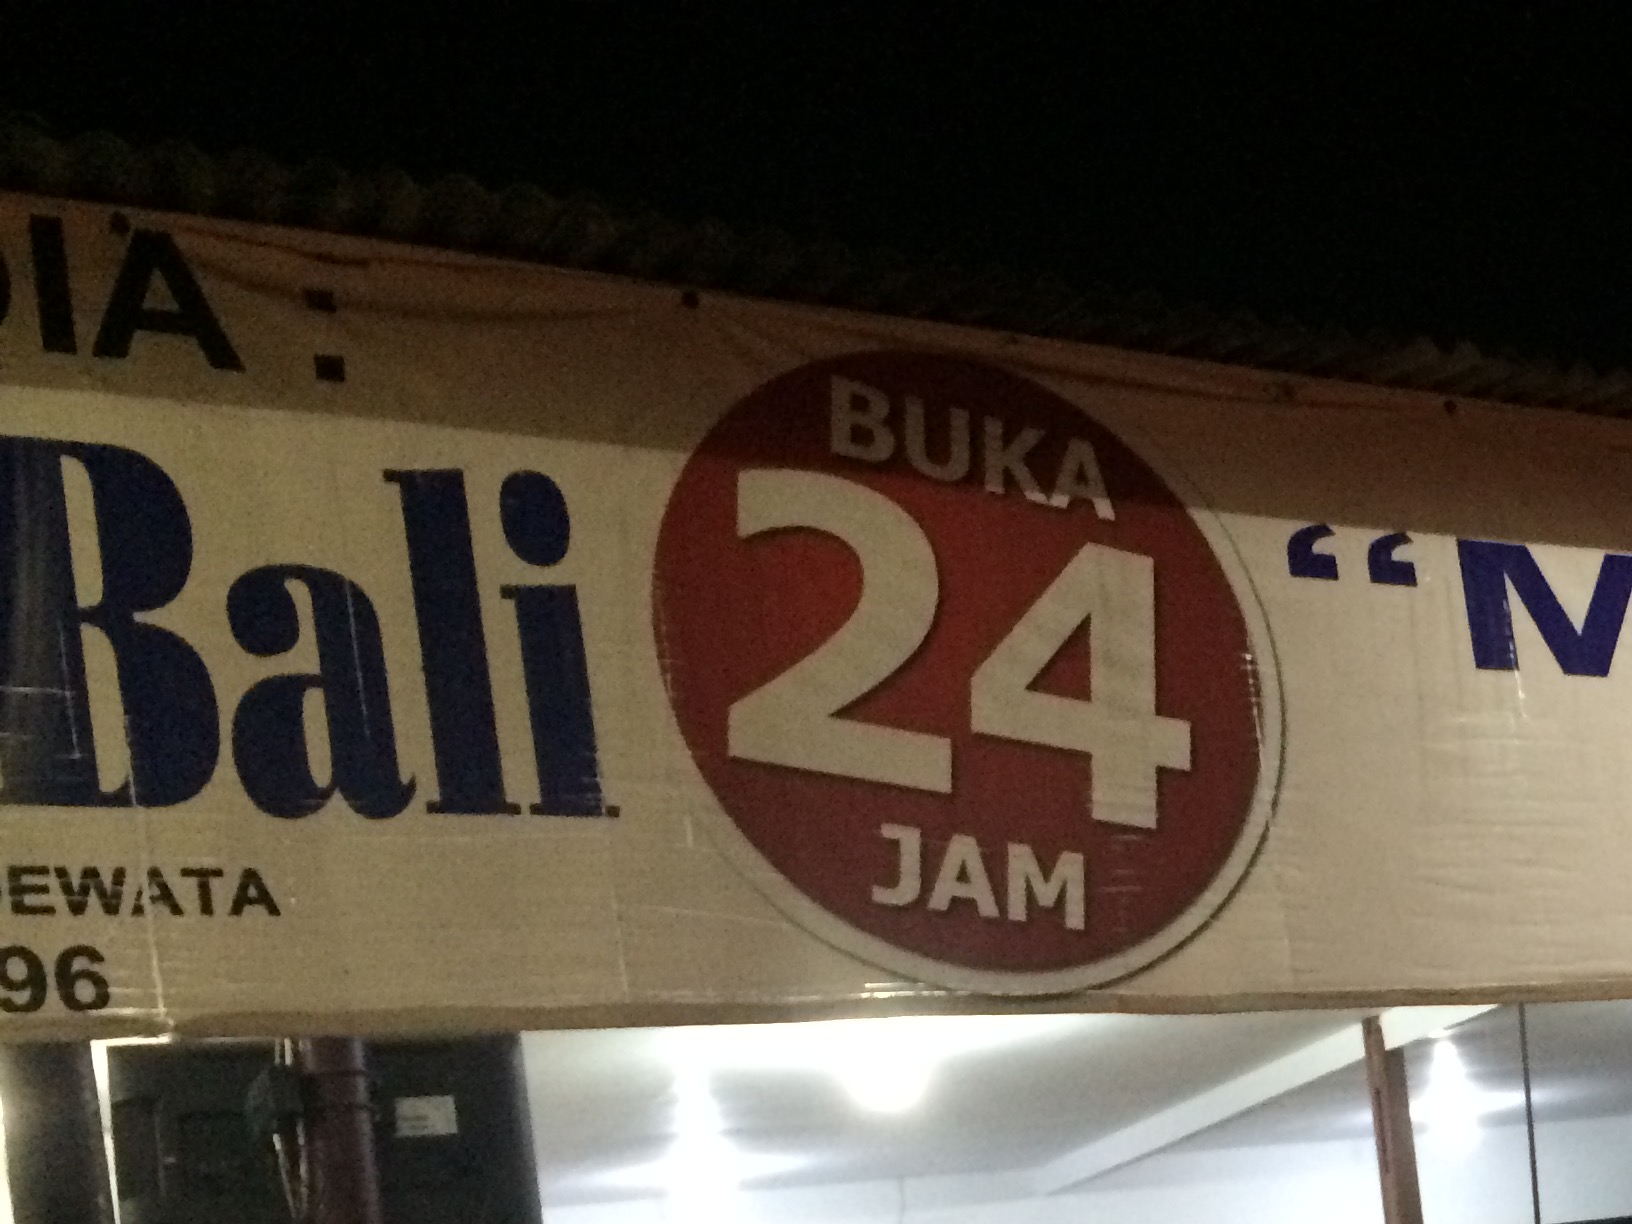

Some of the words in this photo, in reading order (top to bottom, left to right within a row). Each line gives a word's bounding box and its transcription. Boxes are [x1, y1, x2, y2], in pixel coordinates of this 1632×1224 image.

[0, 214, 247, 375] IA
[828, 375, 1116, 521] BUKA
[0, 434, 620, 820] Bali
[727, 467, 1191, 830] 24
[872, 823, 1086, 931] JAM
[0, 945, 110, 1013] 96
